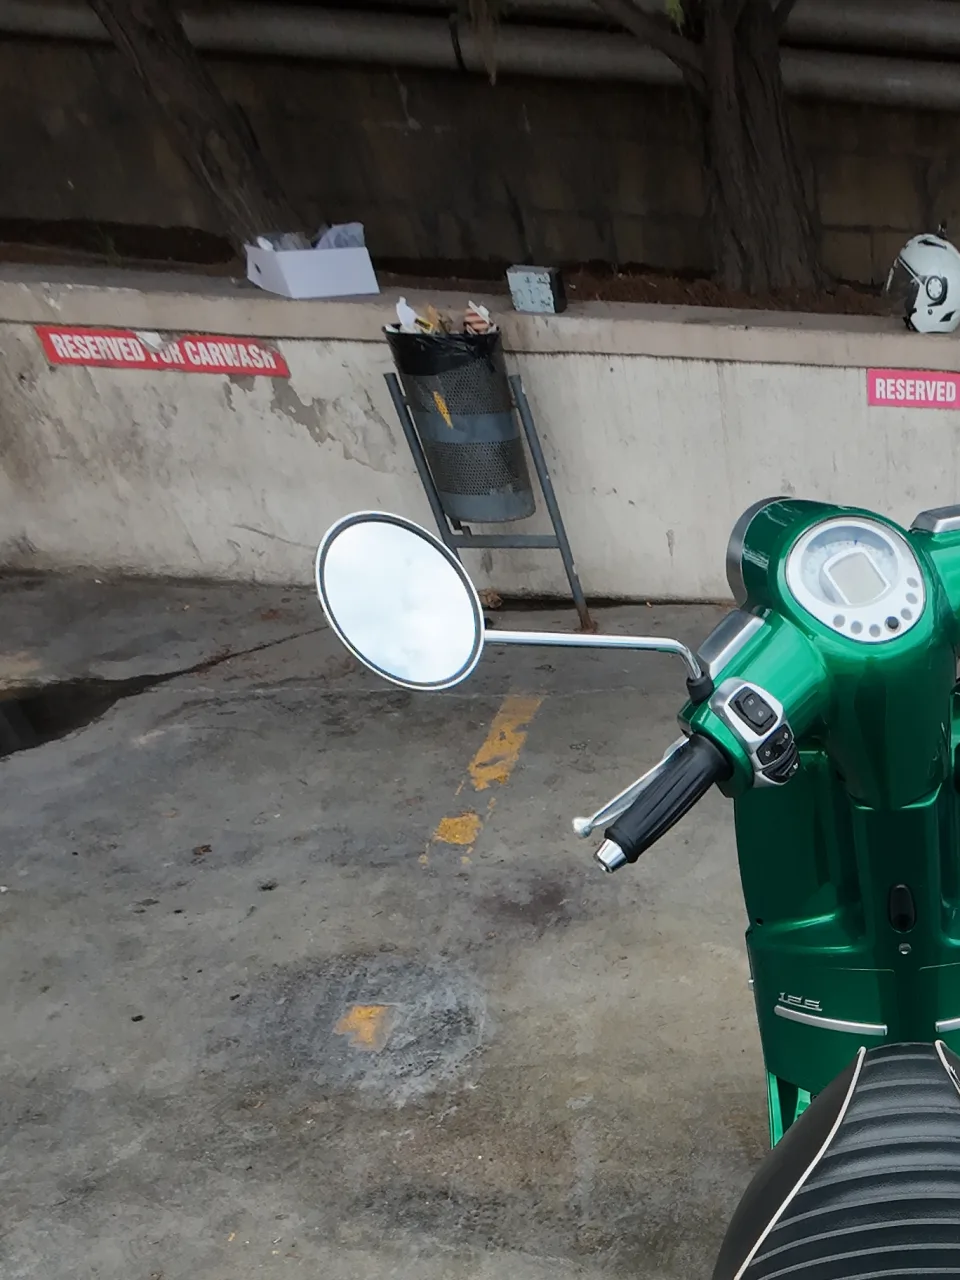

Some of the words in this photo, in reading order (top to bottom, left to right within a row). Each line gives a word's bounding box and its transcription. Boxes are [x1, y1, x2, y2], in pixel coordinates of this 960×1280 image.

[49, 333, 146, 361] RESERVED
[183, 341, 277, 369] CARWASH
[875, 378, 956, 402] RESERVED
